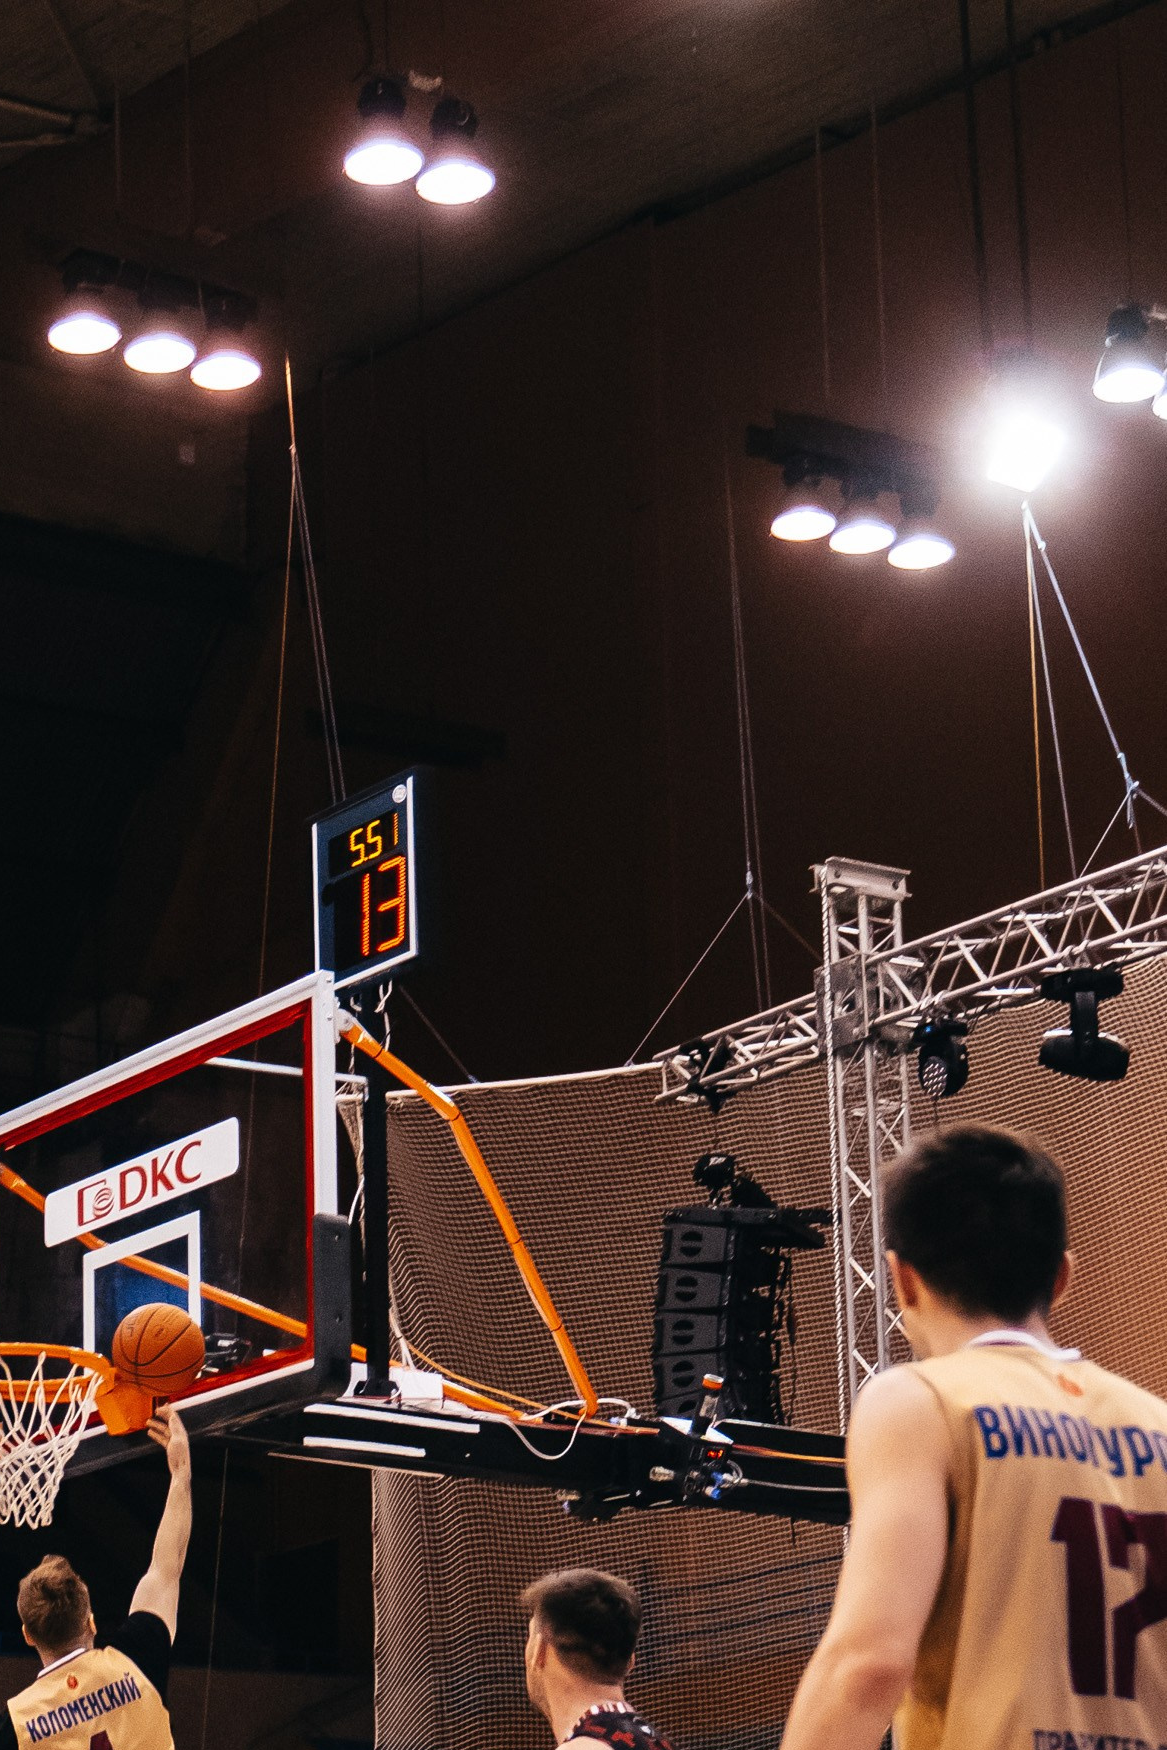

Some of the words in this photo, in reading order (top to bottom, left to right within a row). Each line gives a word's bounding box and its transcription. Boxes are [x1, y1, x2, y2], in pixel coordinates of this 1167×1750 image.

[360, 855, 406, 956] 13
[118, 1140, 202, 1212] DKC
[25, 1671, 142, 1743] КОЛОМЕНСКИЙ
